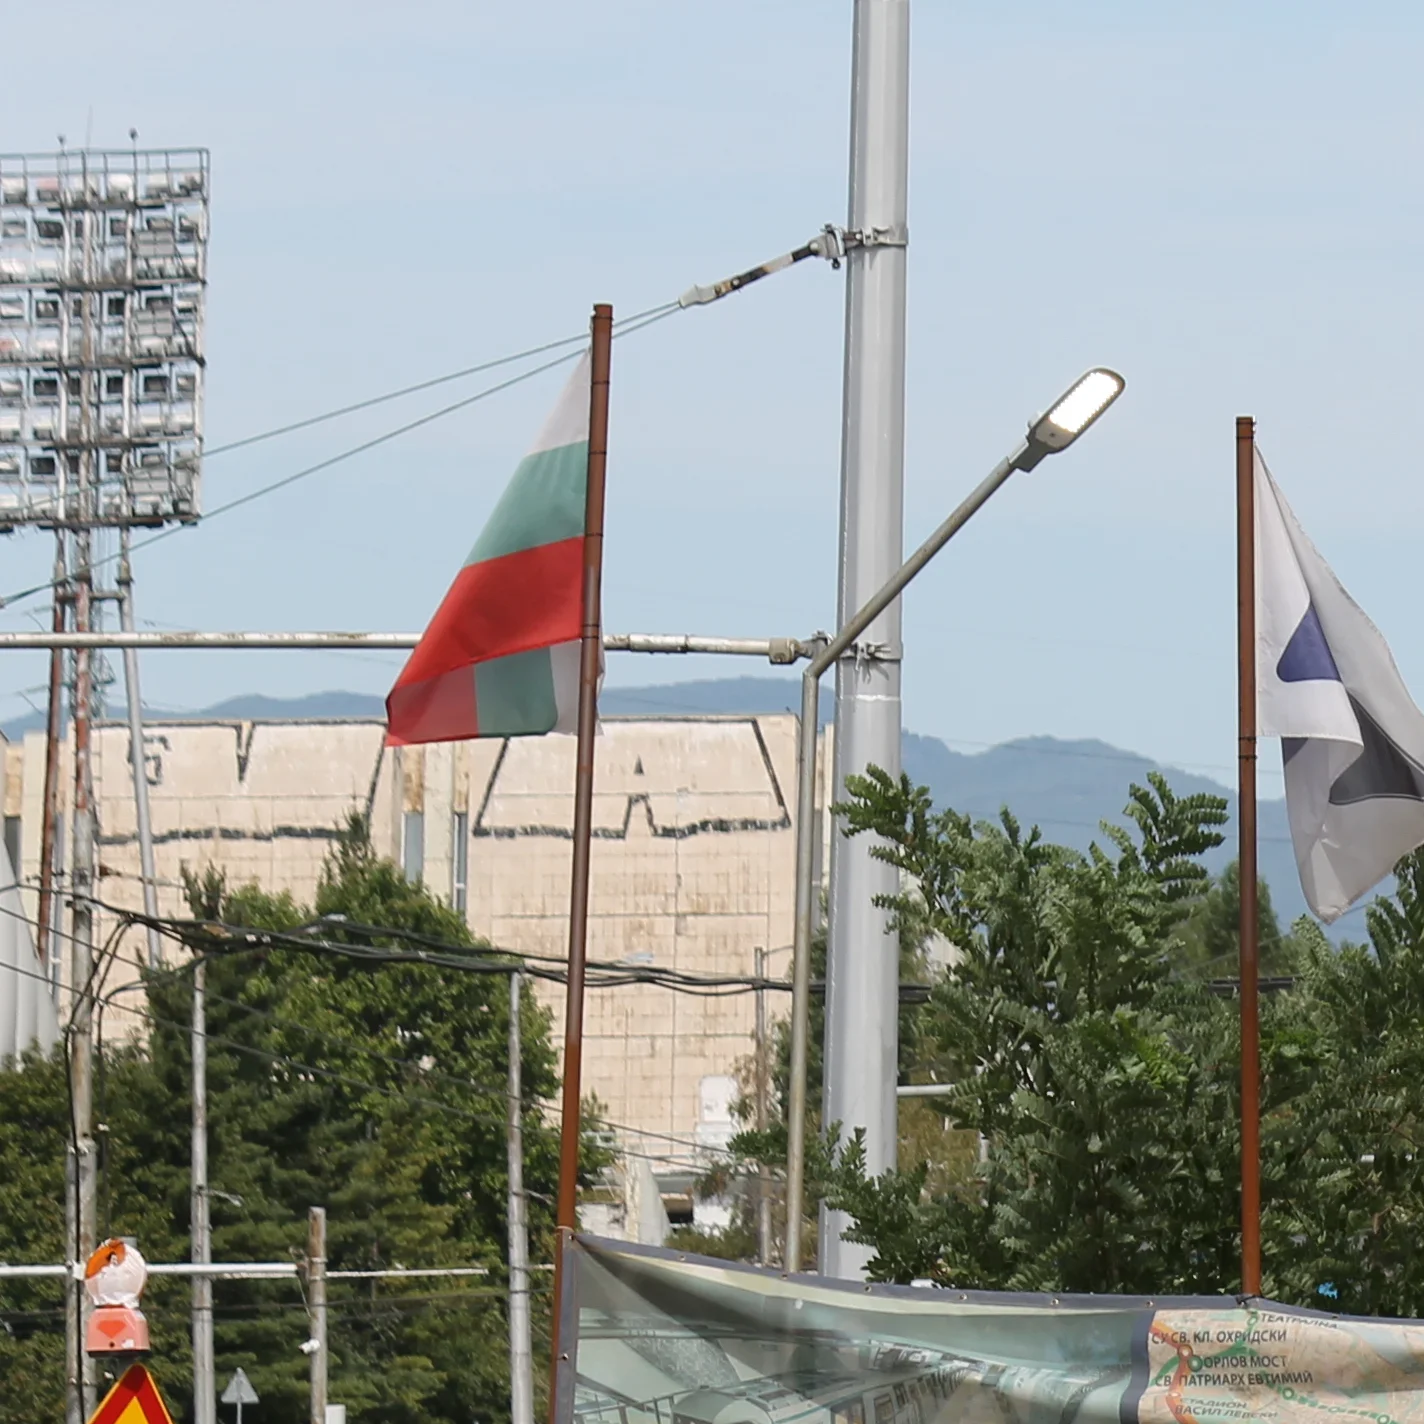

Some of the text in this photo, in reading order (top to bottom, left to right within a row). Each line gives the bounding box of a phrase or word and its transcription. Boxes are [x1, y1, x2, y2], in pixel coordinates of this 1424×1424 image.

[1152, 1329, 1287, 1344] СУ СВ. КЛ. ОХРИДСКИ
[1204, 1355, 1287, 1369] ОРЛОВ МОСТ
[1179, 1373, 1245, 1387] ПАТРИАРХ
[1248, 1370, 1313, 1386] ЕВТИМИЙ
[1174, 1405, 1222, 1416] ВАСИЛ
